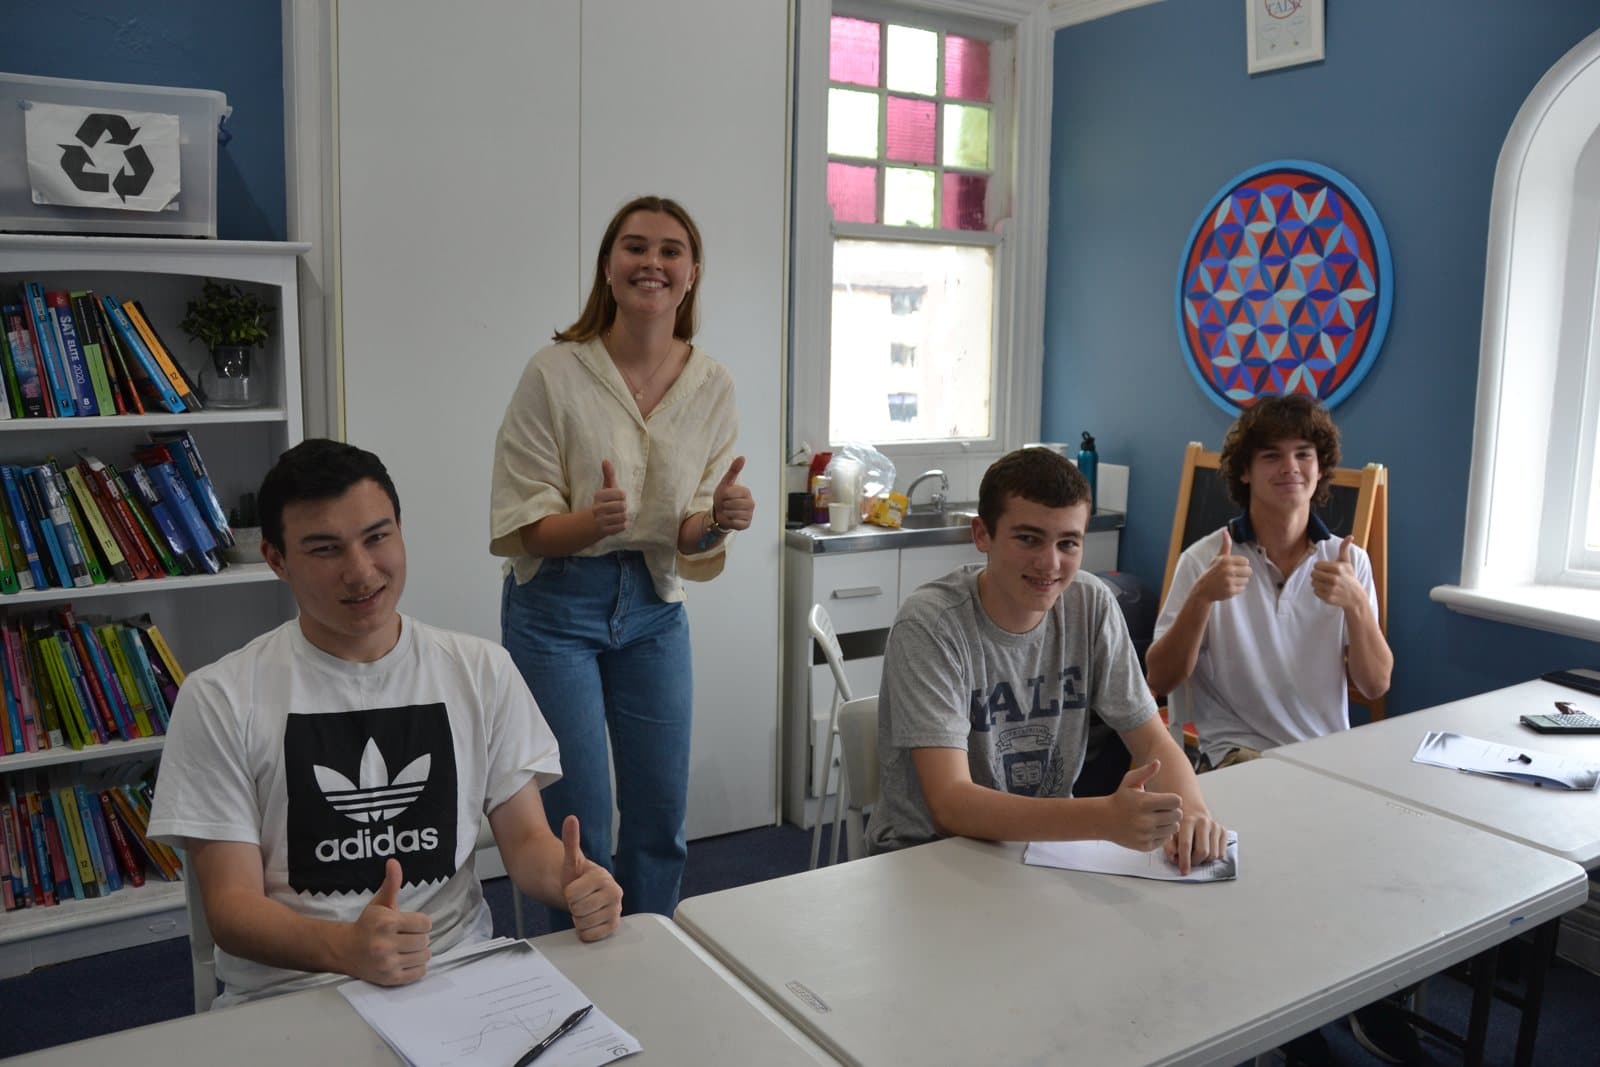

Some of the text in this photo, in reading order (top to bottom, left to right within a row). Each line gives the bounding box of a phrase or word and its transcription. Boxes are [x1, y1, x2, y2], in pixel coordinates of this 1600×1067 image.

[59, 315, 86, 385] SAT ELITE 2020
[314, 825, 439, 862] adidas
